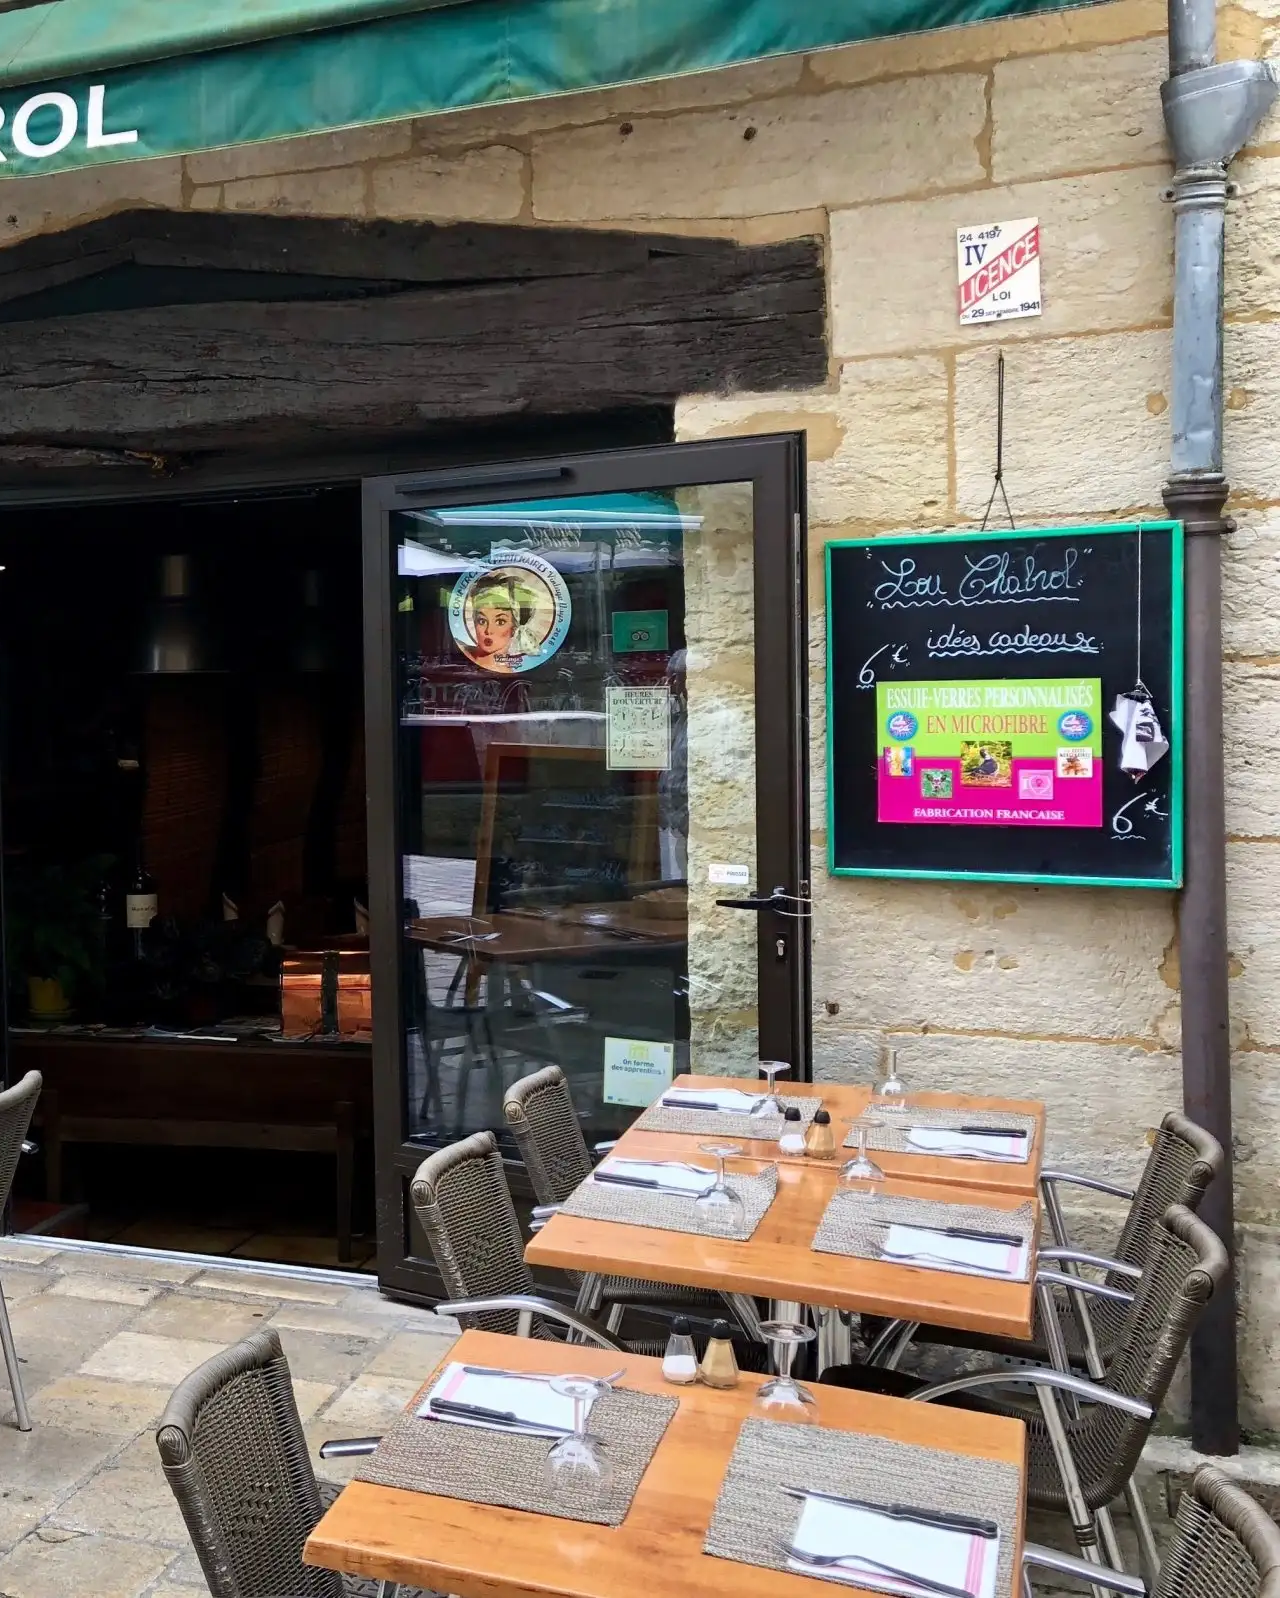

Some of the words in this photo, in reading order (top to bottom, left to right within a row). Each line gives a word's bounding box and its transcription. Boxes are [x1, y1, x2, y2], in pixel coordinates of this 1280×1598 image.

[960, 233, 973, 242] 24
[978, 229, 1002, 240] 4197
[965, 243, 987, 266] IV
[960, 230, 1037, 310] LICENCE
[992, 291, 1011, 301] LOI
[971, 308, 985, 318] 29
[1020, 301, 1040, 312] 1941
[875, 558, 947, 600] Lou
[959, 547, 1078, 600] Chabrol
[927, 624, 980, 651] idées
[887, 686, 981, 709] ESSUIE-VERRES
[984, 681, 1094, 708] PERSONNALISÉS
[927, 715, 947, 734] EN
[951, 714, 1049, 734] MICROFIBRE
[914, 808, 993, 818] FABRICATION
[611, 1063, 623, 1071] des
[633, 1060, 654, 1068] forme
